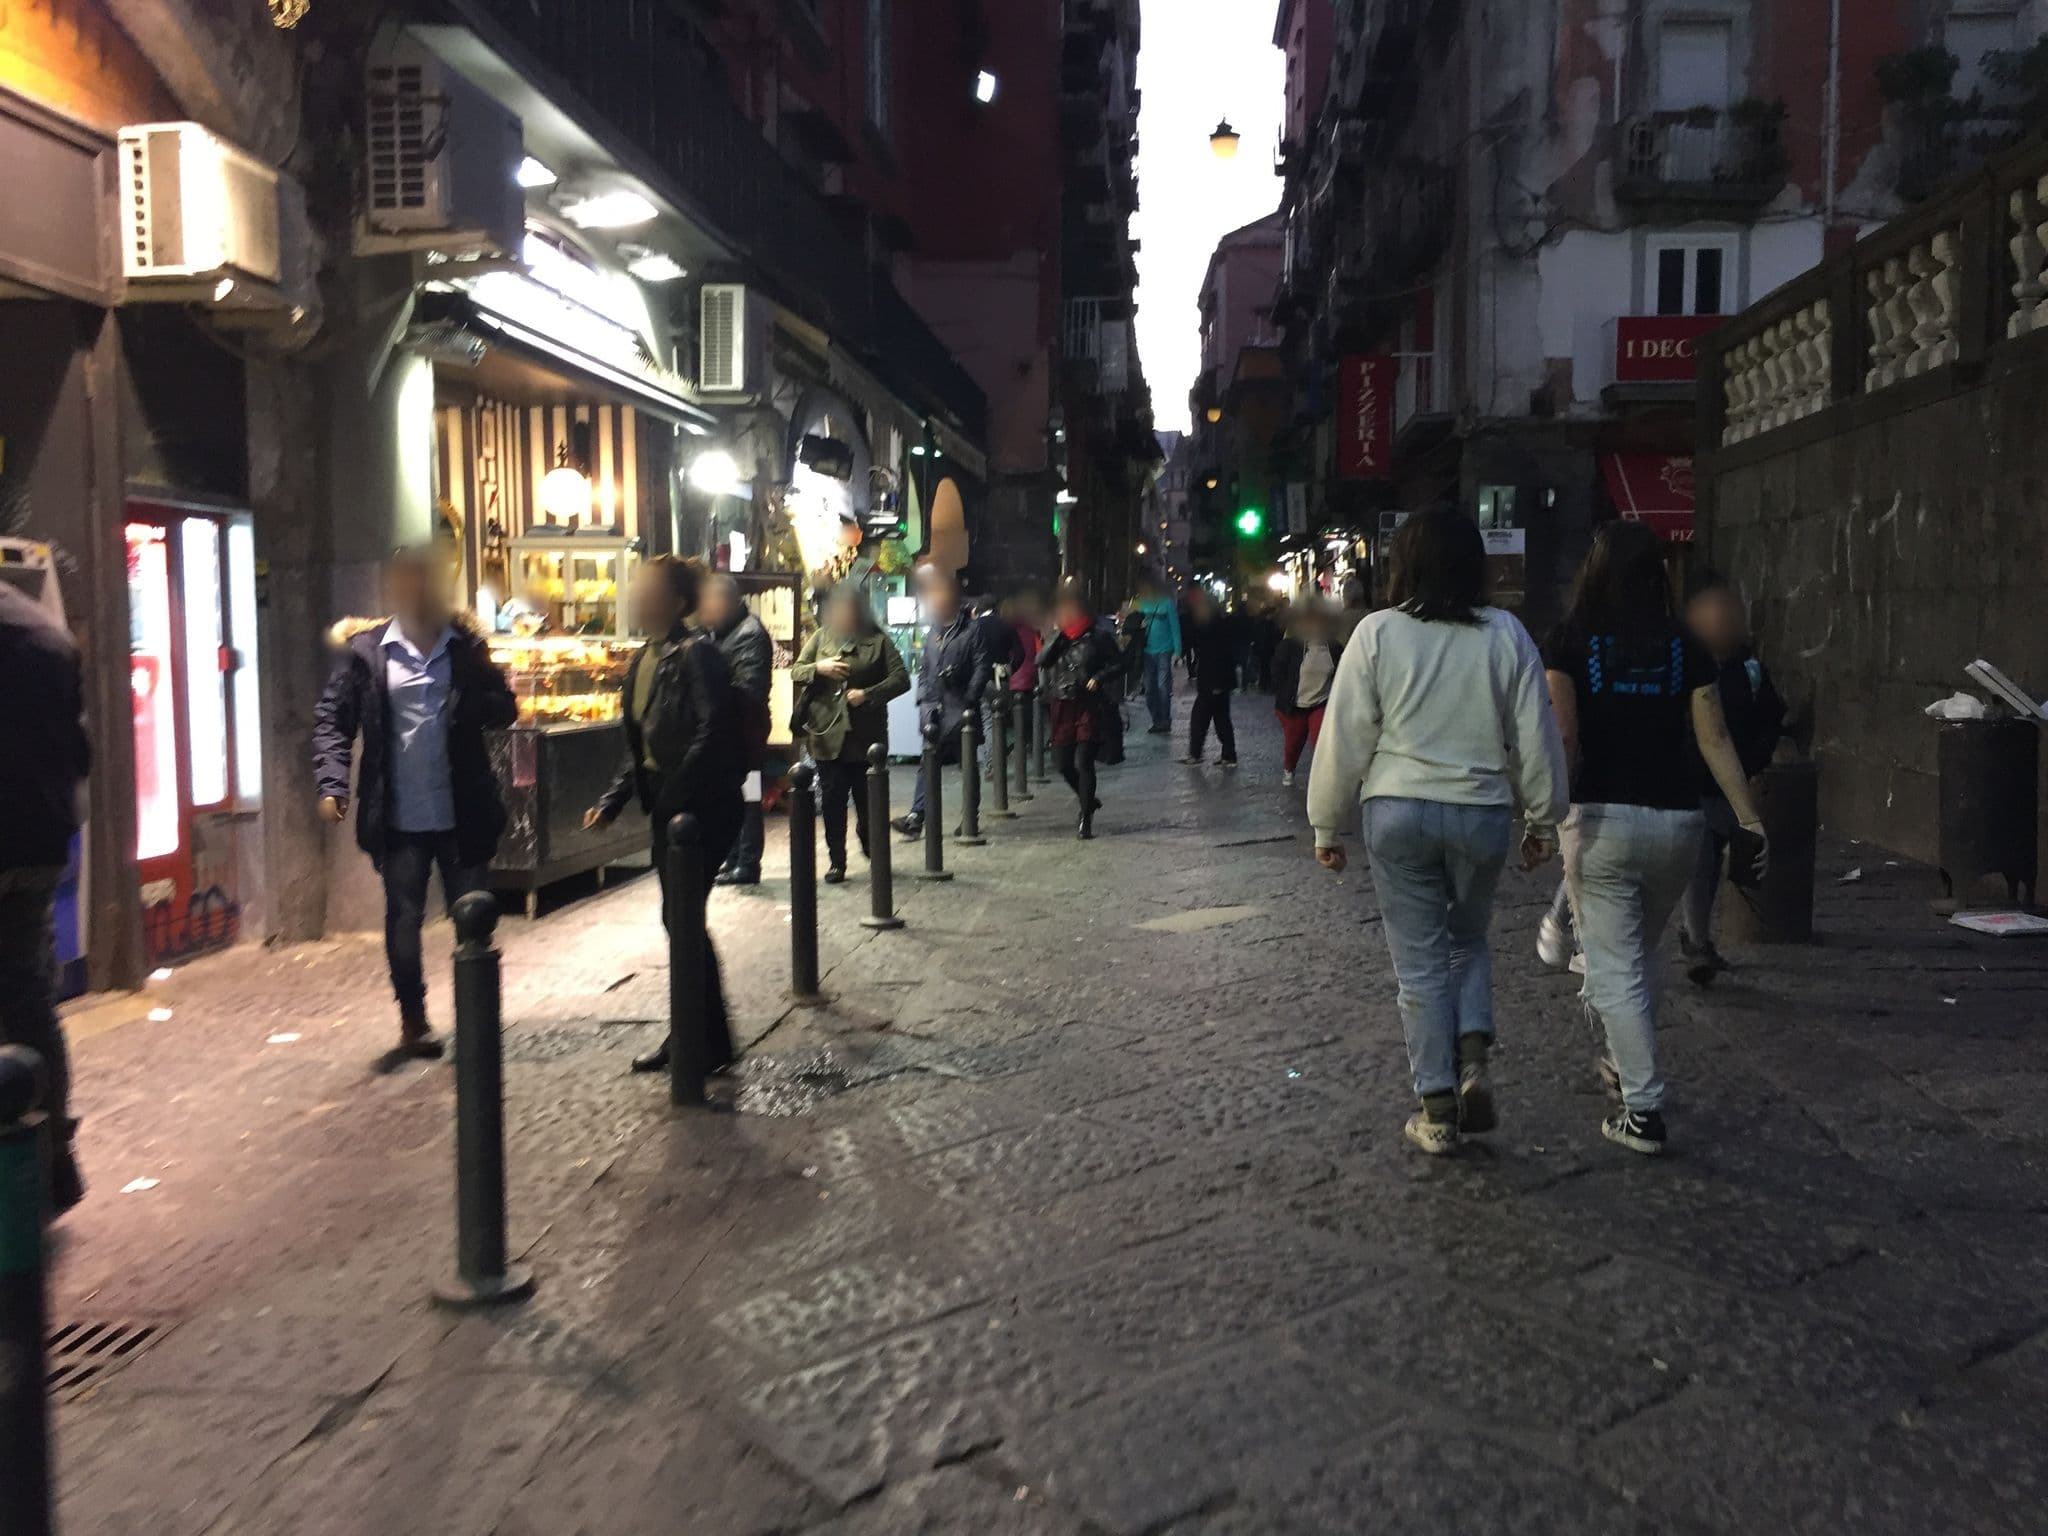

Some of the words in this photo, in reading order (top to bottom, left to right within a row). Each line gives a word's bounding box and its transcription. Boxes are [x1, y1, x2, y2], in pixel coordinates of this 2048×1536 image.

[1626, 338, 1635, 359] I
[1641, 338, 1698, 359] DEC
[1357, 361, 1377, 467] PIZZERIA
